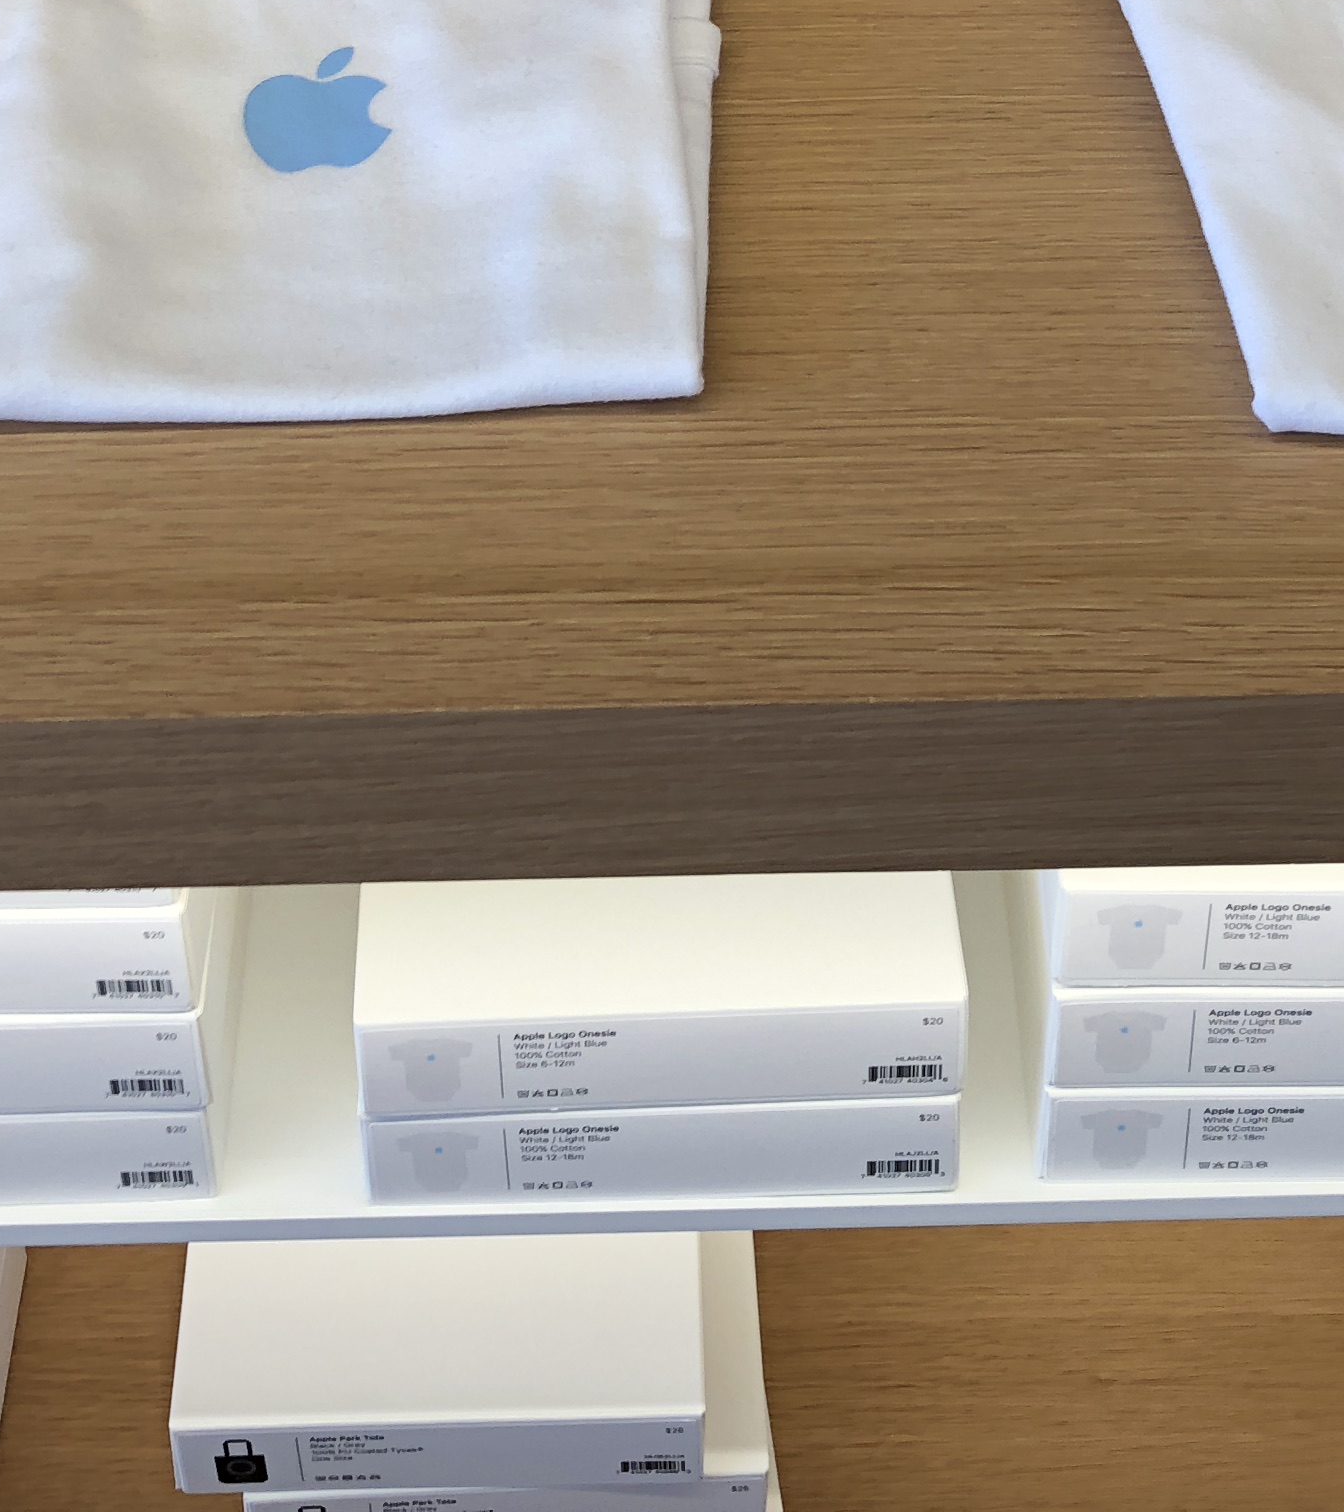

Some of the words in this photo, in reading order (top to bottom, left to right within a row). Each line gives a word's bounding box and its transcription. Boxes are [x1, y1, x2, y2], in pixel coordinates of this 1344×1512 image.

[1225, 903, 1258, 912] Apple
[1261, 903, 1290, 912] Logo
[1292, 903, 1332, 911] Onesie
[1224, 913, 1256, 921] White
[1266, 913, 1293, 923] Light
[1296, 913, 1321, 921] Blue
[1223, 932, 1246, 940] Size
[1249, 932, 1289, 940] 12-18m
[1208, 1009, 1241, 1018] Apple
[1243, 1009, 1271, 1018] Logo
[1274, 1008, 1313, 1017] Onesie
[922, 1017, 944, 1026] $20
[1208, 1018, 1239, 1026] White
[1249, 1018, 1276, 1027] Light
[1278, 1018, 1302, 1026] Blue
[513, 1032, 545, 1041] Apple
[548, 1031, 576, 1040] Logo
[578, 1029, 617, 1038] Onesie
[513, 1042, 545, 1050] White
[554, 1040, 581, 1049] Light
[545, 1050, 583, 1058] Cotton
[515, 1061, 538, 1069] Size
[1203, 1107, 1235, 1115] Apple
[1237, 1107, 1265, 1116] Logo
[1267, 1106, 1305, 1114] Onesie
[919, 1113, 940, 1122] $20
[1203, 1116, 1233, 1124] White
[1242, 1116, 1268, 1125] Light
[1271, 1116, 1294, 1124] Blue
[518, 1127, 550, 1135] Apple
[552, 1126, 579, 1135] Logo
[582, 1125, 620, 1133] Onesie
[519, 1136, 549, 1144] White
[559, 1135, 585, 1143] Light
